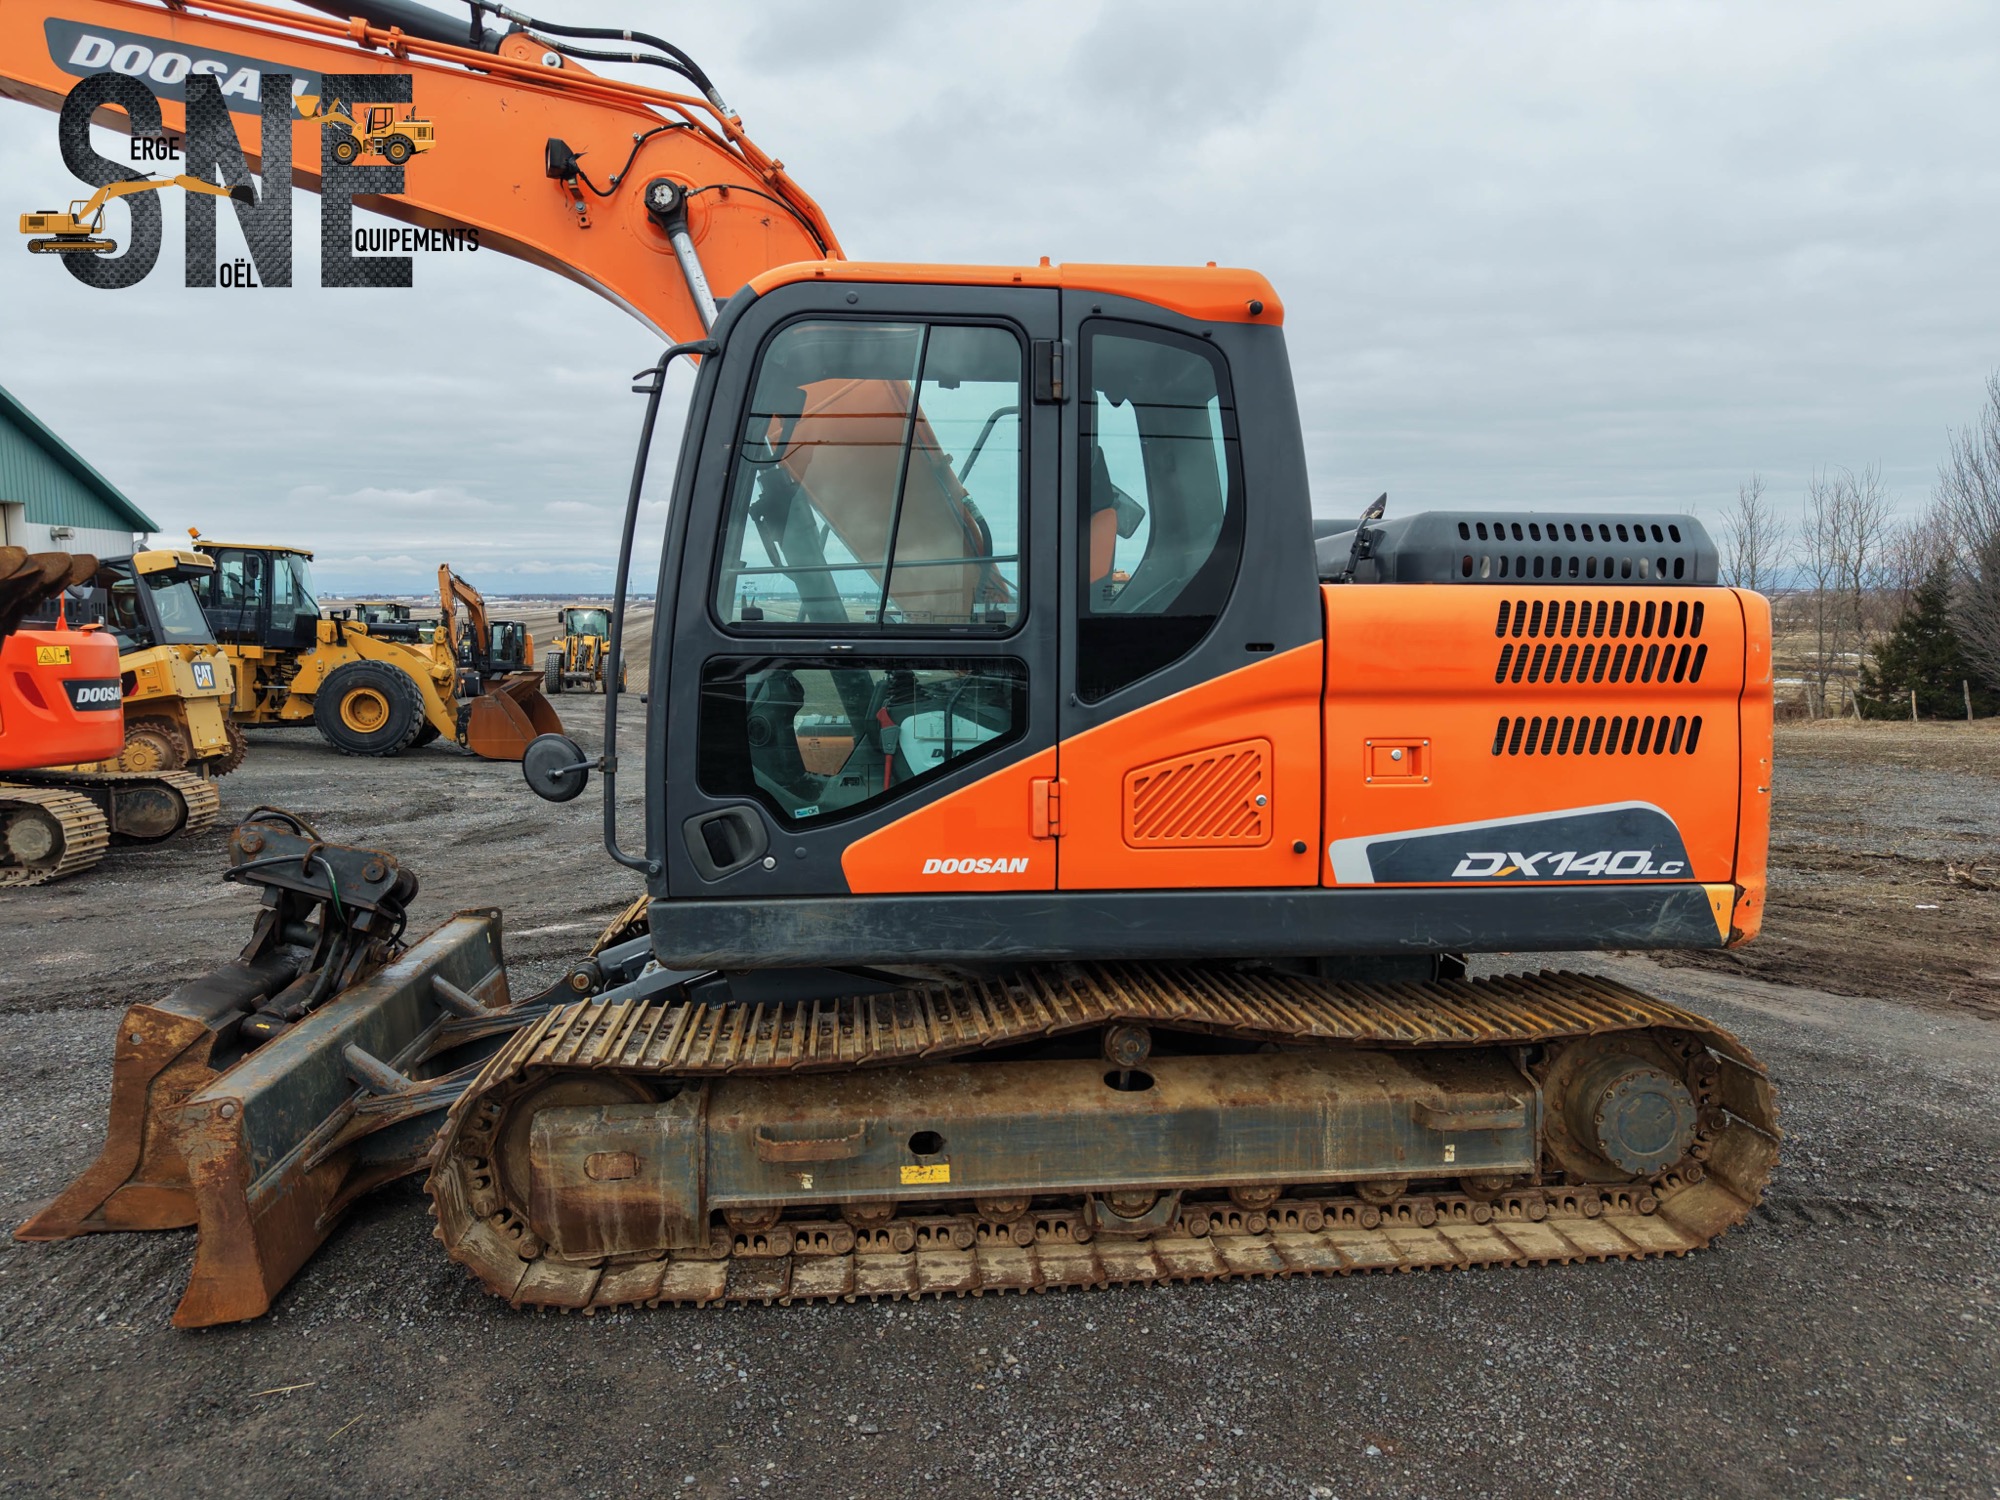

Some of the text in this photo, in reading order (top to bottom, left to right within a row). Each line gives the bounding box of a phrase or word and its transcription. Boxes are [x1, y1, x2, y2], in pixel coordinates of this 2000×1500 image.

[193, 664, 213, 687] CAT
[76, 687, 121, 703] DOOSA
[922, 858, 1029, 874] DOOSAN
